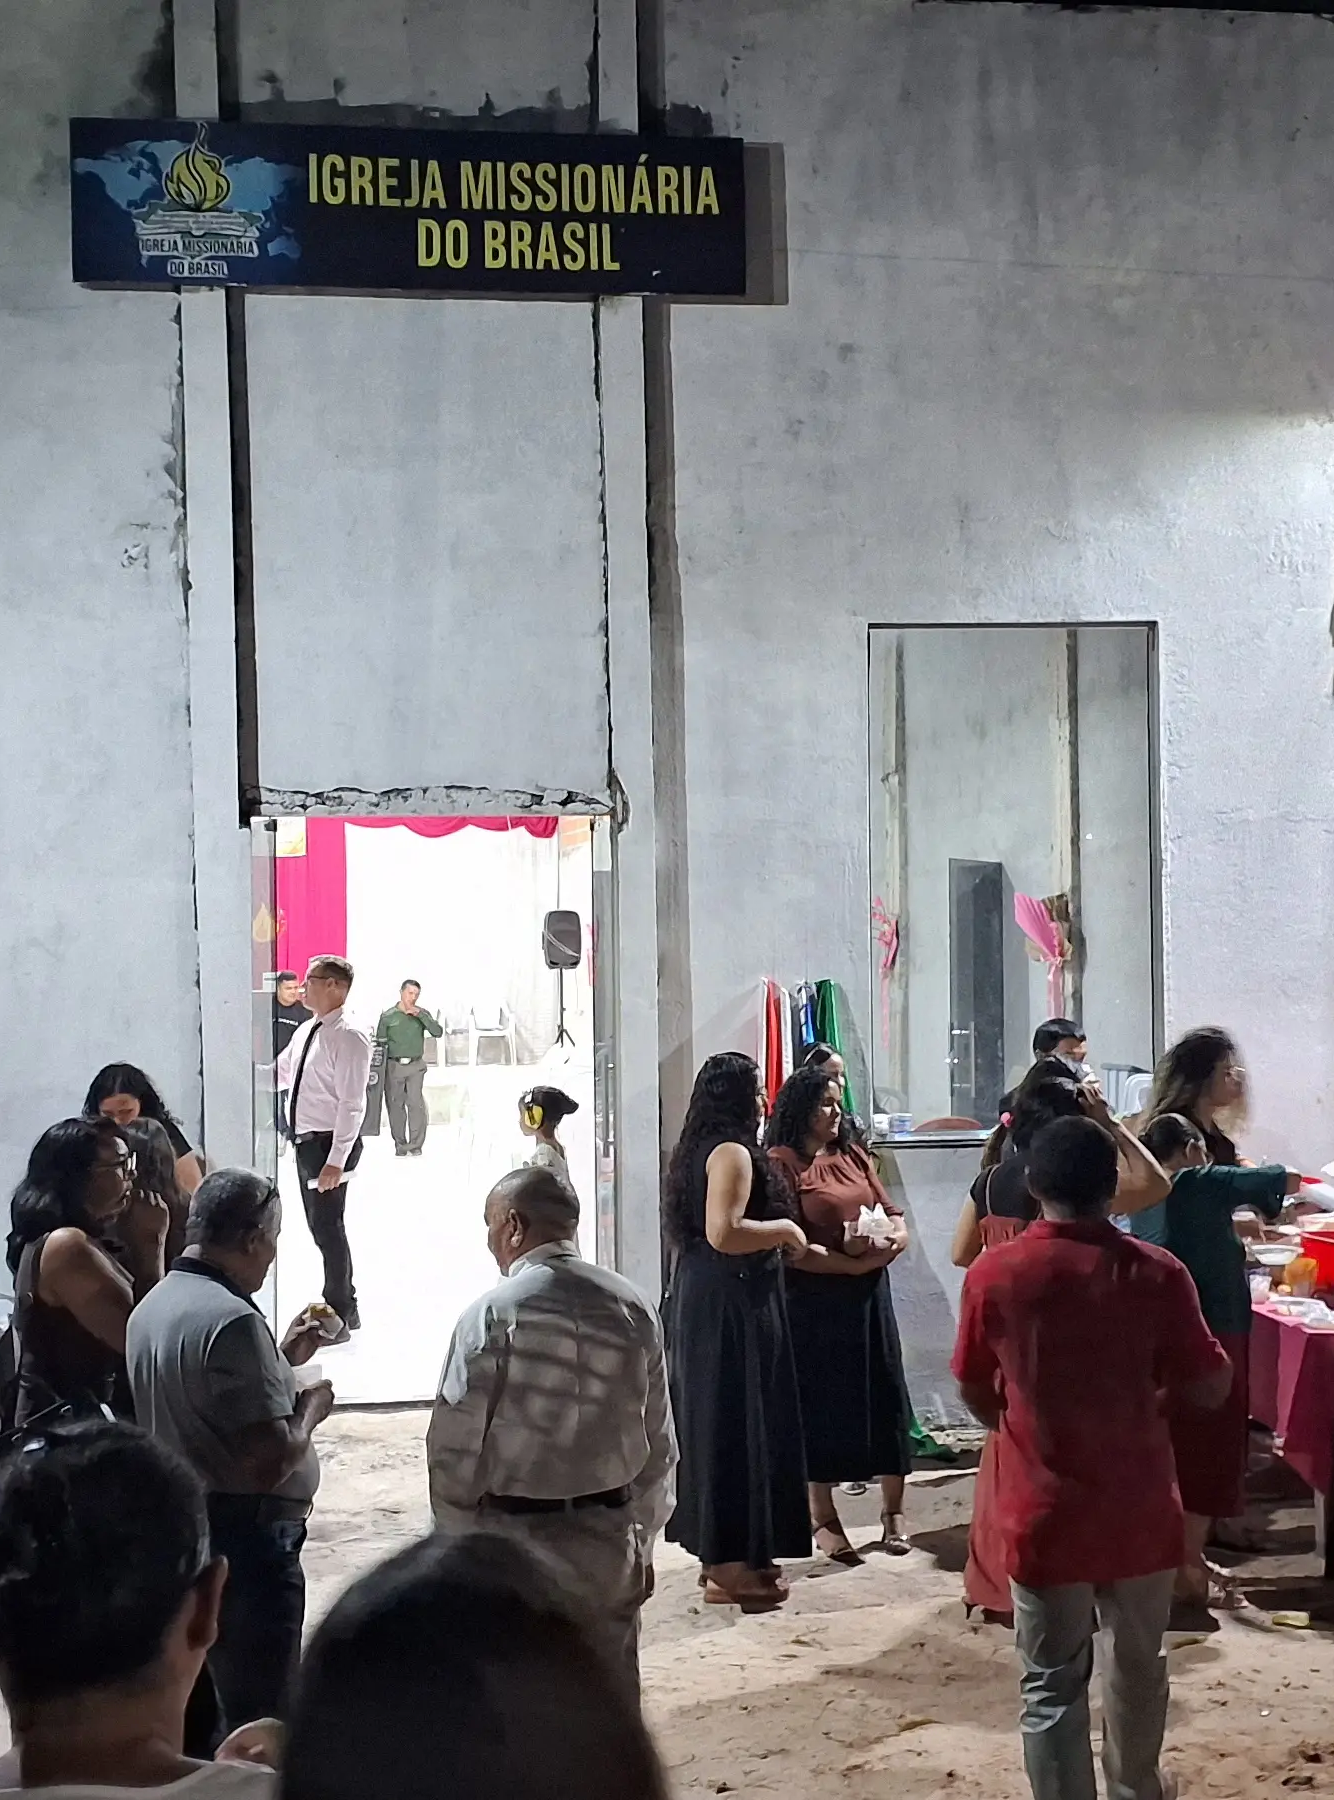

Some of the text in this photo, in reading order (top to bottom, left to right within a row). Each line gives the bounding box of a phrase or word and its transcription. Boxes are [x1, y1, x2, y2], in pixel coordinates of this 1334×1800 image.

[308, 153, 720, 215] IGREJA MISSIONÁRIA
[142, 238, 179, 253] IGREJA
[417, 217, 621, 271] DO BRASIL
[170, 260, 227, 276] DO BRASIL
